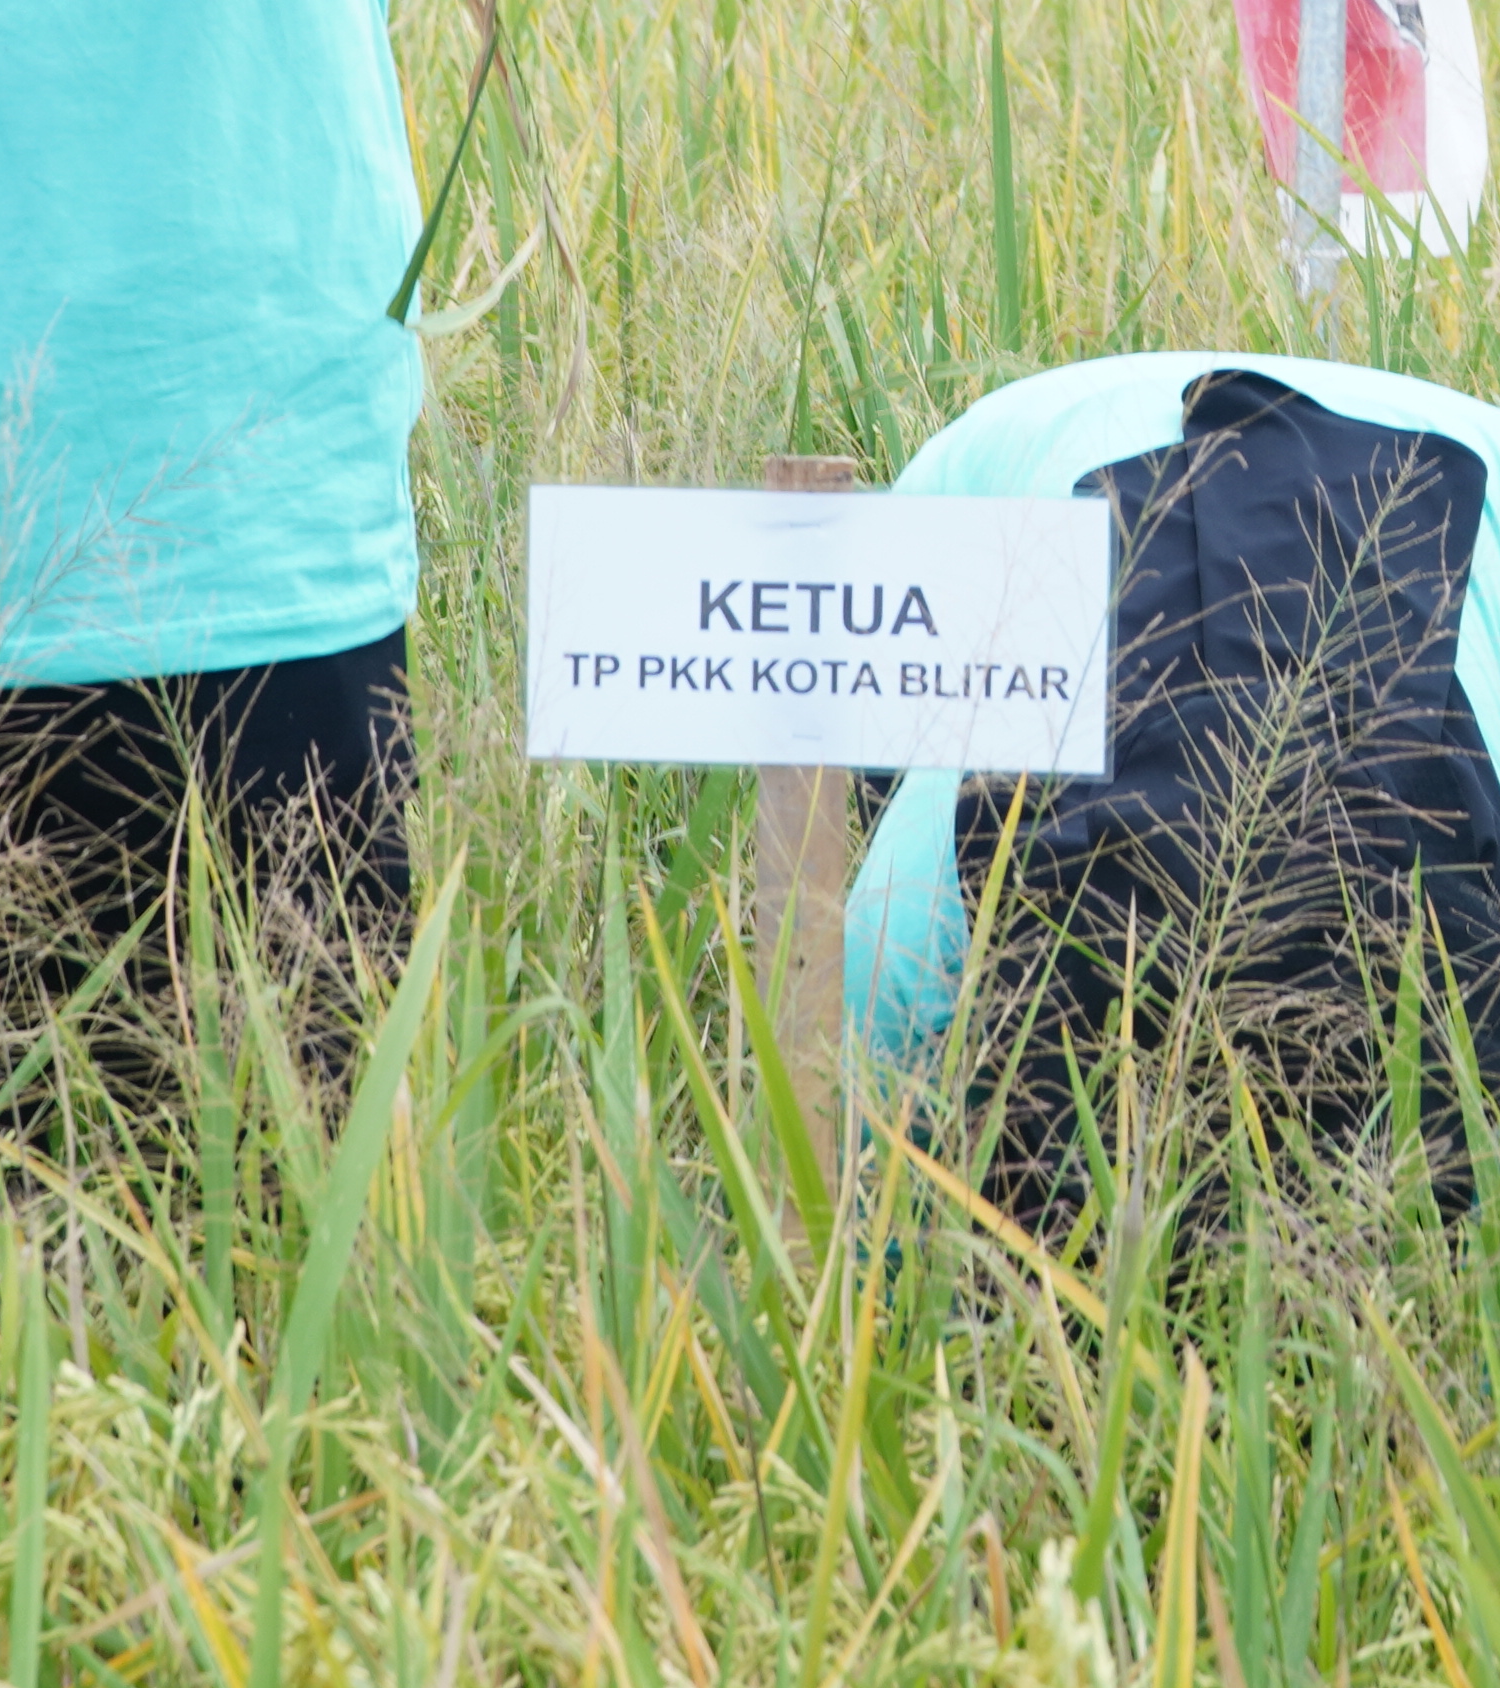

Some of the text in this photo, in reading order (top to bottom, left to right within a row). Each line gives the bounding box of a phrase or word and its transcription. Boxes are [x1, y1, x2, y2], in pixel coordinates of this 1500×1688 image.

[699, 579, 940, 637] KETUA
[564, 653, 1071, 701] TP PKK KOTA BLITAR
